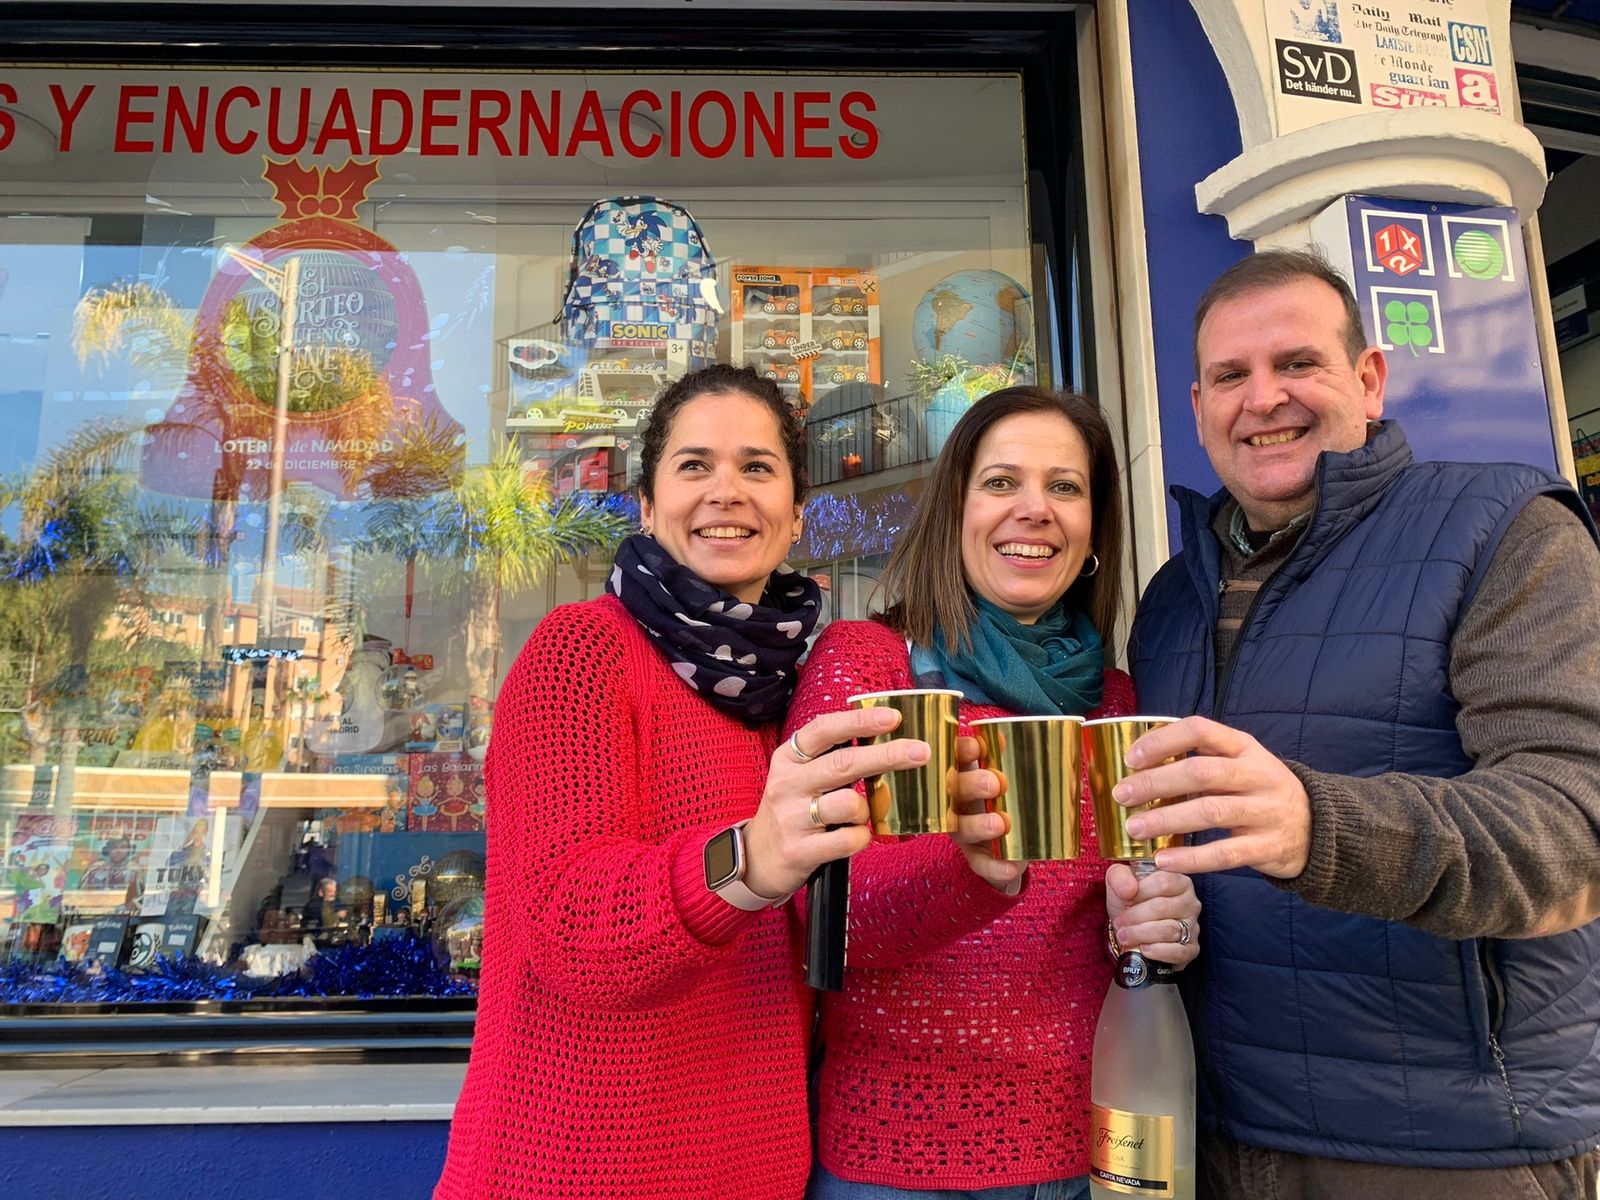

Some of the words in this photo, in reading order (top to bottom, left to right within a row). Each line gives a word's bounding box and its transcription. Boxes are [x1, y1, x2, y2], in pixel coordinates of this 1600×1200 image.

[1409, 12, 1442, 27] Mail
[1375, 21, 1400, 36] Daily
[1401, 25, 1448, 42] Telegraph
[1283, 46, 1352, 84] SvD
[1285, 78, 1303, 91] Det
[1305, 81, 1339, 95] händer
[1340, 89, 1356, 98] nu.
[49, 84, 97, 153] Y
[113, 85, 880, 159] ENCUADERNACIONES
[252, 291, 364, 338] SRTEO
[612, 324, 669, 340] SONIC
[671, 344, 685, 354] 3+
[290, 440, 309, 453] de
[311, 439, 394, 453] NAVIDAD
[246, 460, 262, 470] 22
[285, 459, 357, 470] DICIEMBRE
[353, 763, 399, 774] Sirenas
[418, 763, 438, 773] Las
[1122, 966, 1142, 975] BRUT
[1096, 1127, 1145, 1150] Freixenet
[1100, 1171, 1116, 1181] CARTA
[1116, 1176, 1141, 1187] NEVADA
